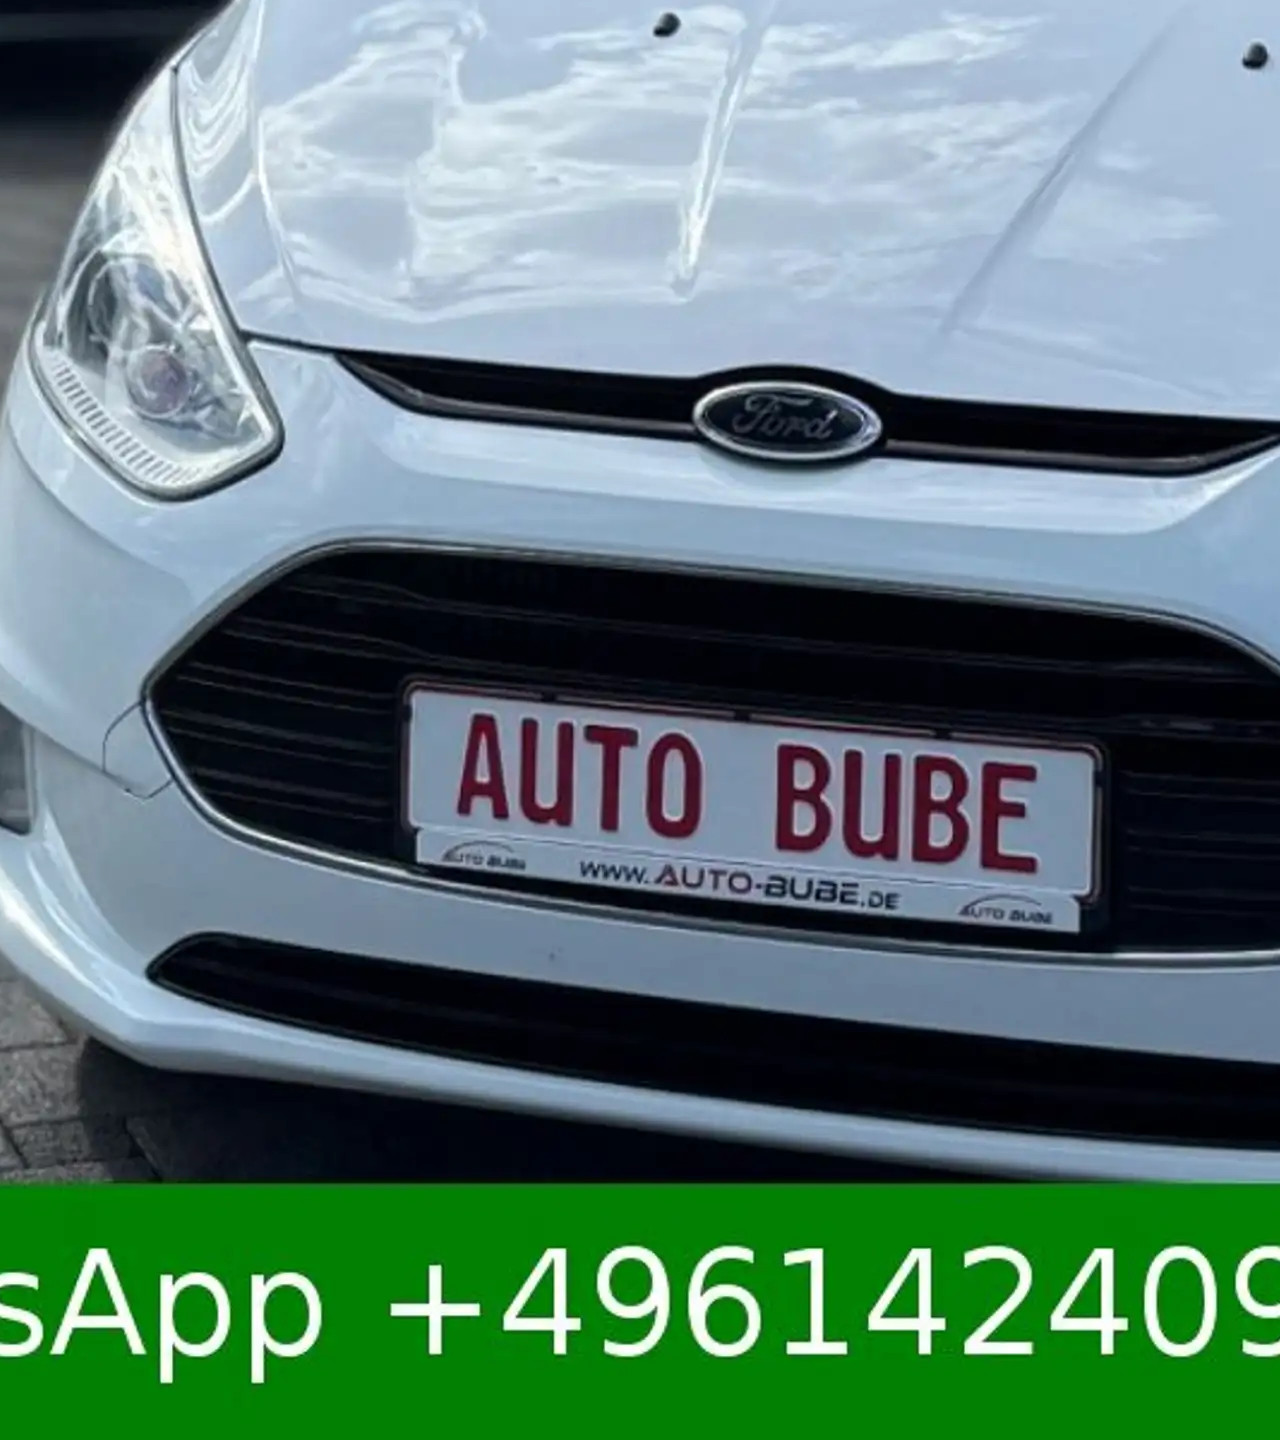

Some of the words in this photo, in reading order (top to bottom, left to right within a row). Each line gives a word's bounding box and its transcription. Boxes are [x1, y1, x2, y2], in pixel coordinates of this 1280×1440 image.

[732, 394, 838, 439] Ford
[456, 712, 703, 840] AUTO
[775, 743, 1039, 875] BUBE
